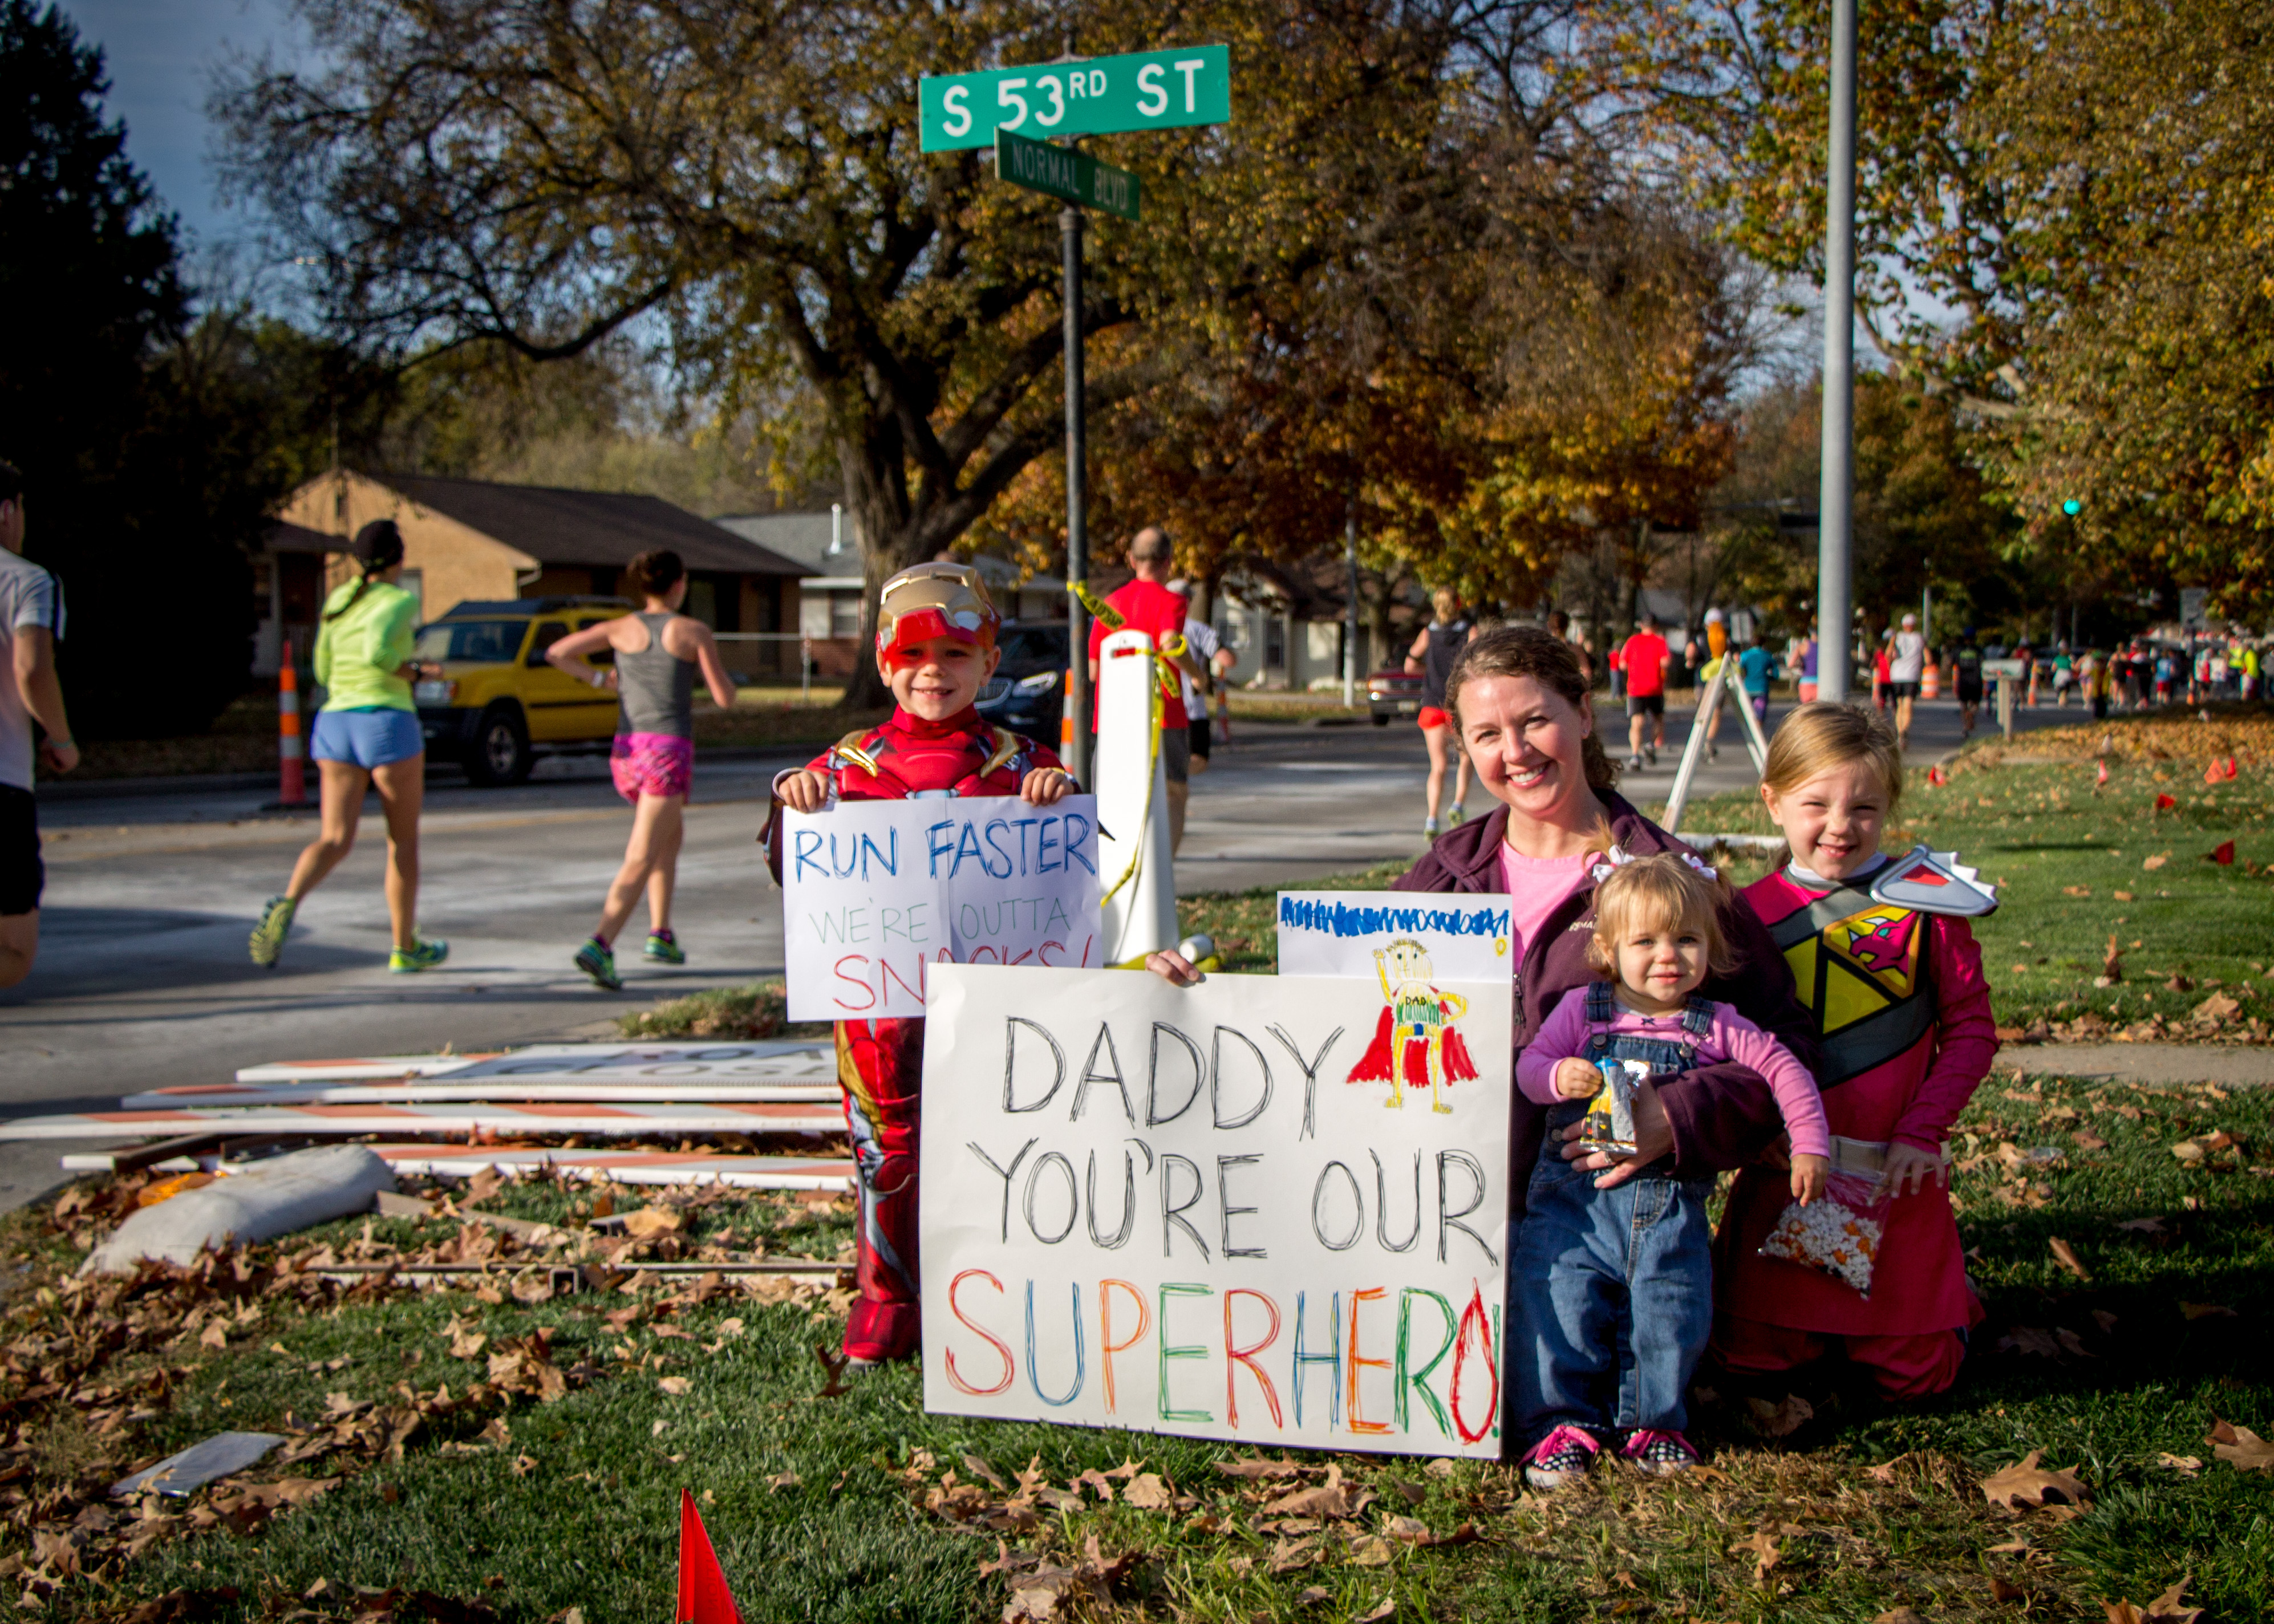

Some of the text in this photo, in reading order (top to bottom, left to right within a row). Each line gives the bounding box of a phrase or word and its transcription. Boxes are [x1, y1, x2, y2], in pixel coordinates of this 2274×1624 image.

[942, 59, 1205, 137] S 53RD ST
[1012, 139, 1130, 211] NORMAL BLVD
[795, 813, 1096, 883] RUN FASTER
[808, 897, 1072, 944] WE'RE OUTTA
[1405, 996, 1427, 1006] DAD
[1002, 1015, 1345, 1142] DADDY
[966, 1137, 1498, 1267] YOU'RE OUR
[945, 1268, 1501, 1445] SUPERHERO!
